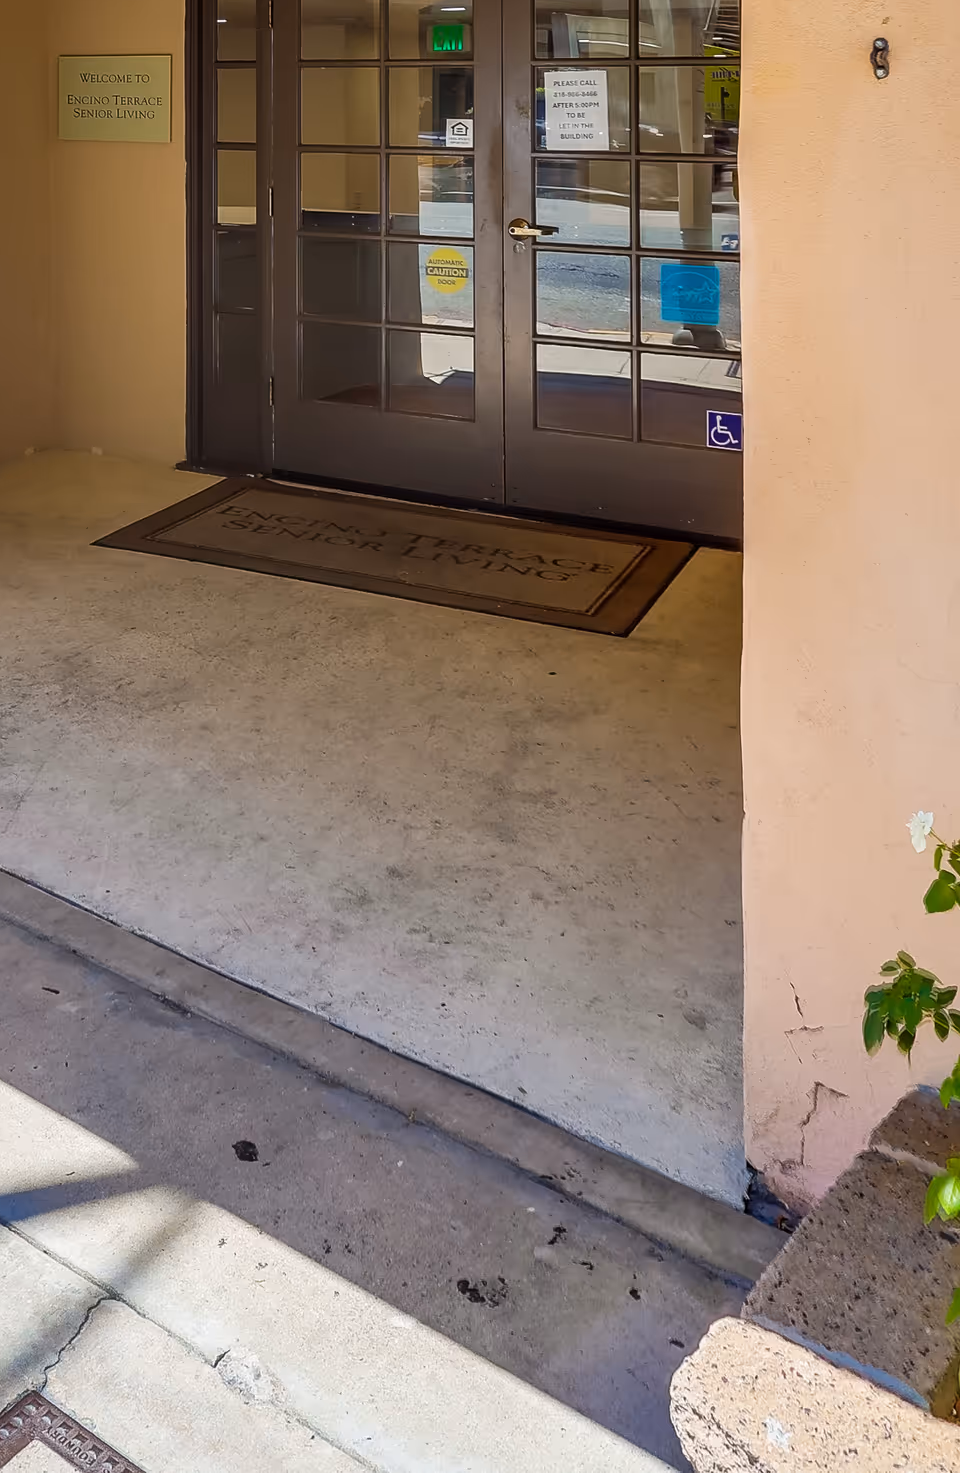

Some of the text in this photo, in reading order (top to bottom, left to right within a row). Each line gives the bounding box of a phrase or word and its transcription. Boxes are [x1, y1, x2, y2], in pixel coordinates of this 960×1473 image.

[79, 72, 151, 84] WELCOME TO
[67, 94, 163, 107] ENCINO TERRACE
[73, 107, 155, 120] SENIOR LIVING
[428, 258, 464, 266] AUTOMATIC
[427, 267, 467, 277] CAUTION
[222, 519, 578, 583] SENIOR LIVING
[404, 532, 615, 575] TERRACE
